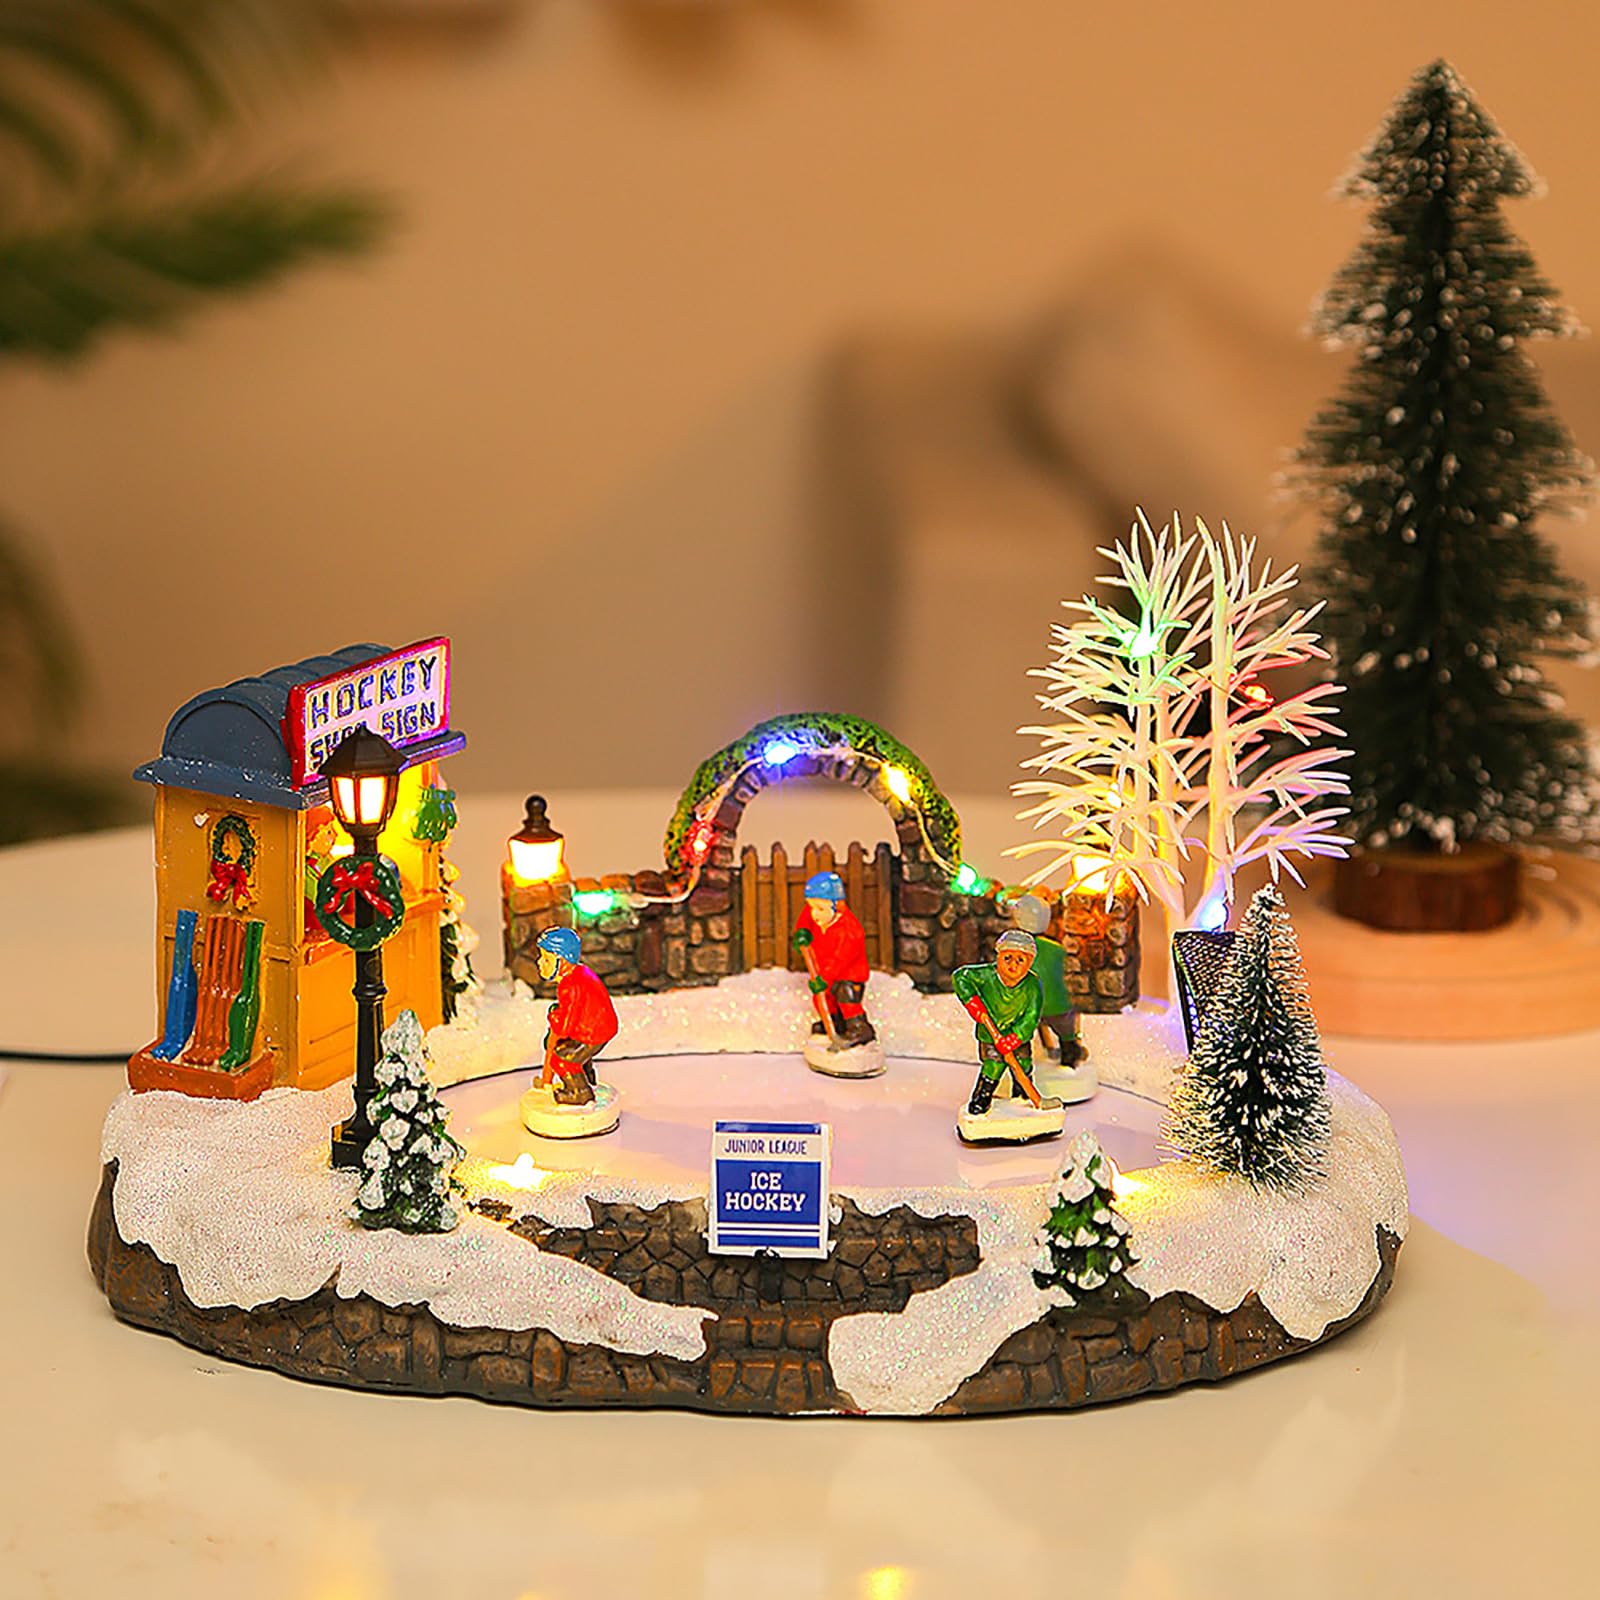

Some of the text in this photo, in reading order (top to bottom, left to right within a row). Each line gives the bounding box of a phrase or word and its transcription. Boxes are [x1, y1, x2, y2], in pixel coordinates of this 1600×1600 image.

[311, 656, 437, 729] HOCKEY
[382, 701, 436, 740] SIGN
[724, 1139, 807, 1155] JUNIOR LEAGUE
[750, 1171, 782, 1190] ICE
[725, 1191, 806, 1212] HOCKEY
